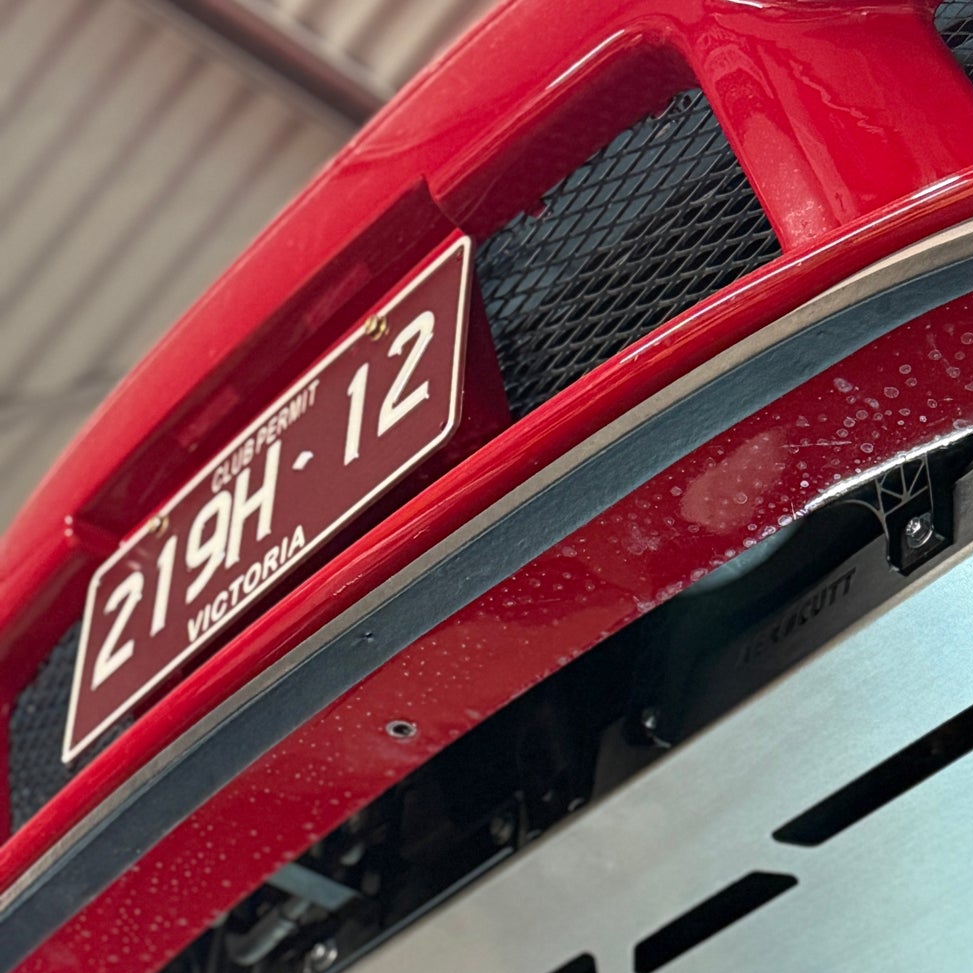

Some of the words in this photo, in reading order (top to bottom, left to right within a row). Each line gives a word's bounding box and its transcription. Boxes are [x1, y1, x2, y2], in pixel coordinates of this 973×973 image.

[211, 438, 255, 493] CLUB
[255, 379, 320, 455] PERMIT
[187, 525, 306, 643] VICTORIA
